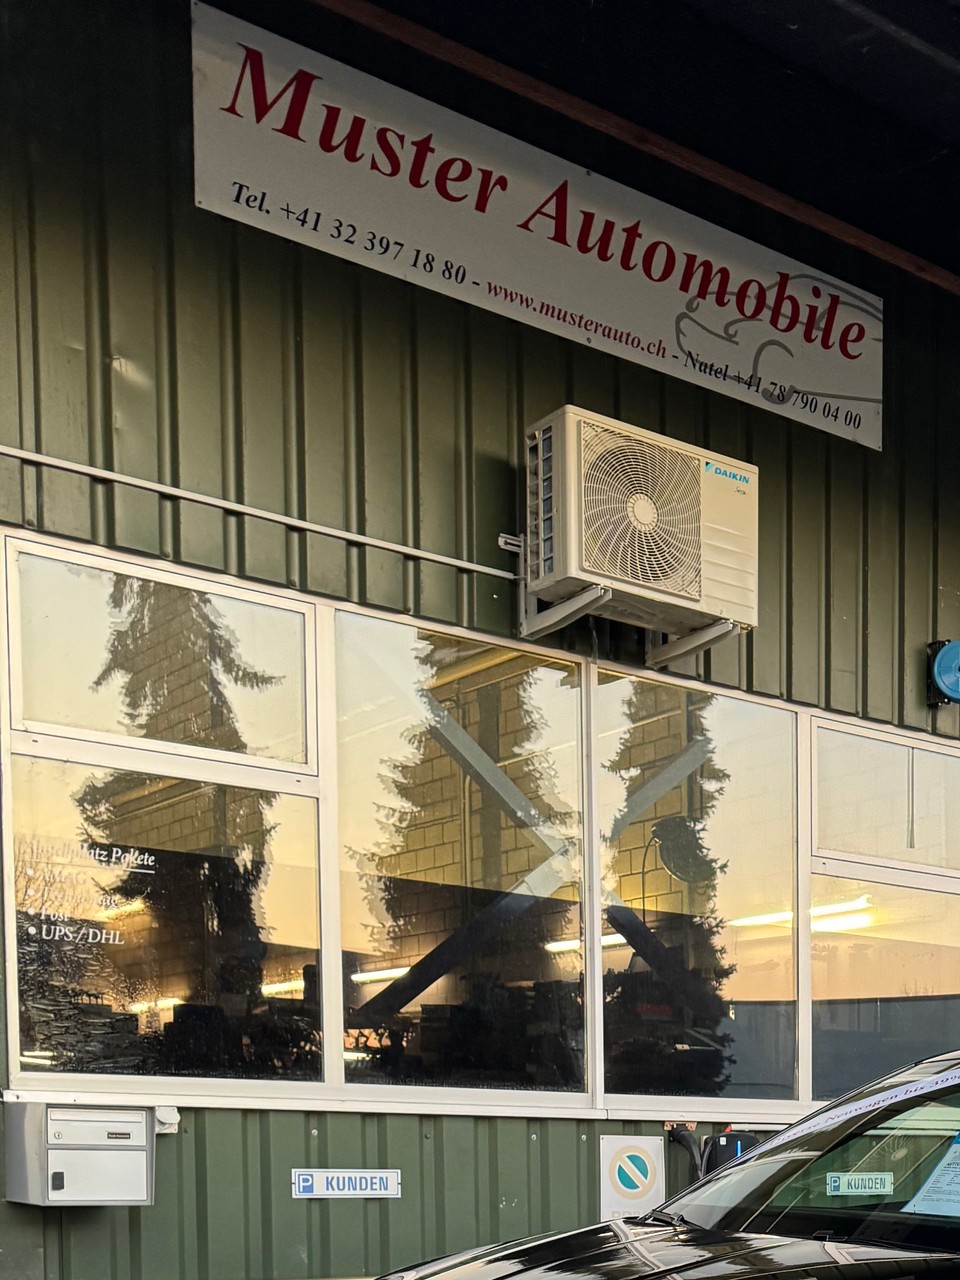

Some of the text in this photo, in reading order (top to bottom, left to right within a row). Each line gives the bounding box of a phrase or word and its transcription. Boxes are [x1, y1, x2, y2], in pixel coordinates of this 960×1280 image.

[220, 42, 866, 360] Muster Automobile
[232, 181, 271, 214] Tel.
[280, 203, 322, 232] +41
[330, 218, 357, 245] 32
[363, 231, 404, 260] 397
[410, 248, 435, 273] 18
[442, 259, 466, 285] 80
[486, 280, 667, 359] www.musterauto.ch
[684, 349, 729, 381] Natel
[732, 370, 762, 393] +41
[769, 381, 786, 402] 78
[793, 390, 818, 414] 790
[822, 402, 839, 422] 04
[844, 410, 862, 430] 00
[714, 467, 750, 484] DAIKIN
[111, 847, 155, 866] Pakete
[825, 1094, 898, 1124] Neuwagen
[326, 1176, 389, 1191] KUNDEN
[847, 1177, 886, 1190] KUNDEN
